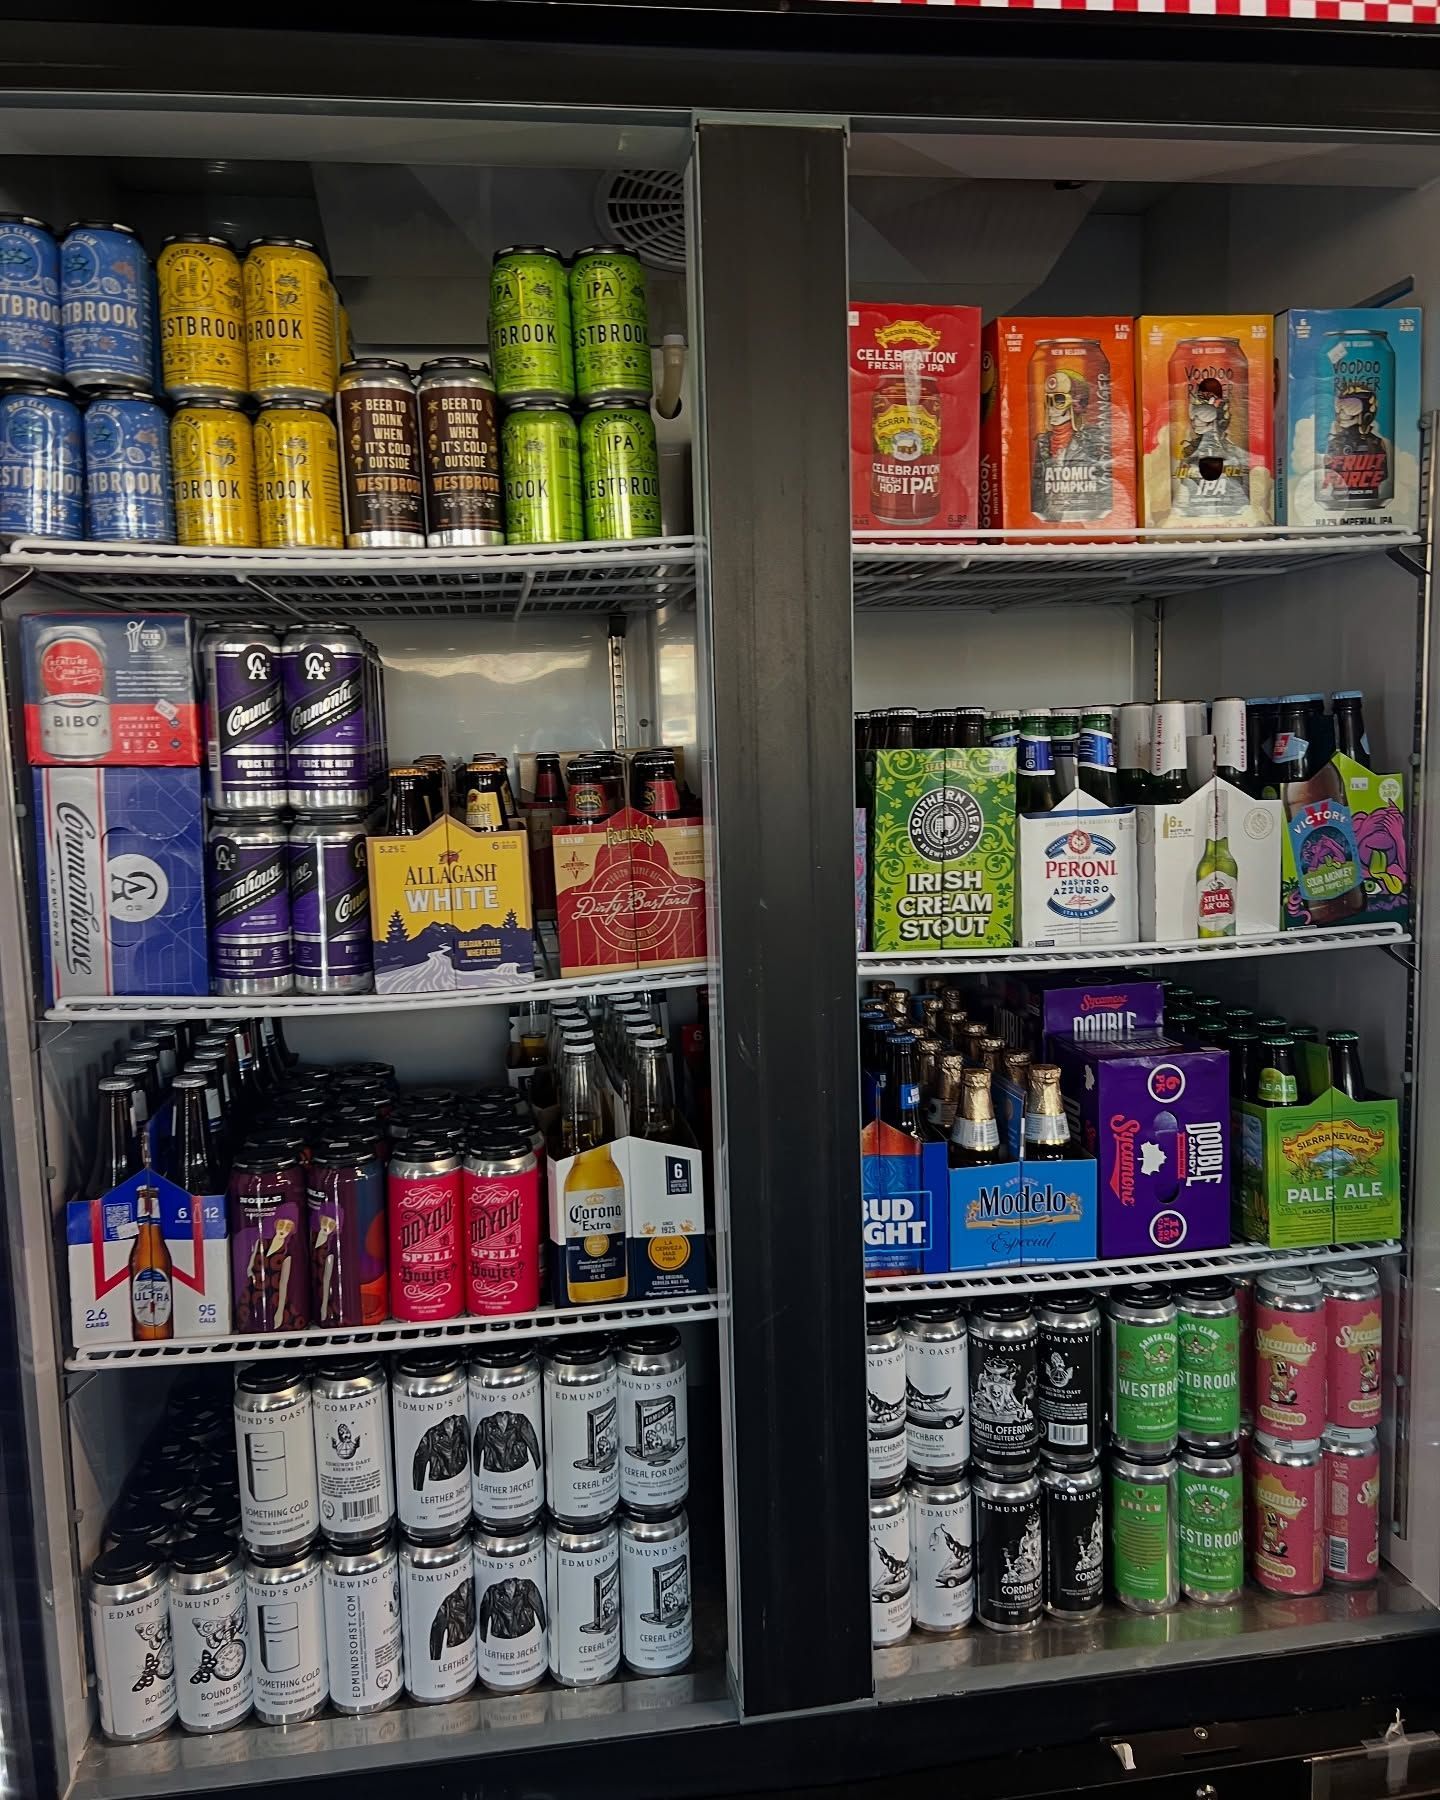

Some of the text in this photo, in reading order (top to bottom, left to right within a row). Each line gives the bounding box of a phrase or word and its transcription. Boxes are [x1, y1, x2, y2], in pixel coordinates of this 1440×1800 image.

[576, 264, 591, 287] INDIA
[613, 266, 627, 281] ALE
[587, 281, 614, 300] IPA
[857, 348, 957, 363] CELEBRATION
[868, 361, 945, 372] FRESH HOP IPA
[1184, 365, 1234, 381] VOODOO
[1333, 359, 1381, 375] VOODOO
[366, 399, 406, 413] BEER TO
[442, 398, 482, 410] BEER TO
[372, 413, 403, 426] DRINK
[447, 413, 479, 425] DRINK
[595, 414, 646, 438] INDIA PALE ALE
[878, 416, 936, 430] SIERRA NEVADA
[374, 428, 403, 440] WHEN
[450, 427, 479, 439] WHEN
[365, 442, 412, 456] IT'S COLD
[441, 441, 488, 454] IT'S COLD
[608, 435, 634, 452] IPA
[369, 456, 410, 470] OUTSIDE
[445, 455, 487, 468] OUTSIDE
[872, 463, 940, 475] CELEBRATION
[1045, 467, 1098, 481] ATOMIC
[878, 476, 901, 484] FRESH
[902, 477, 934, 495] IPA
[880, 483, 902, 494] HOP
[1045, 481, 1097, 494] PUMPKIN
[54, 715, 100, 728] BIBO
[925, 760, 968, 773] SEASONAL
[911, 790, 980, 836] SOUTHERN TIER
[1293, 810, 1347, 835] VICTORY
[606, 824, 655, 848] Founders
[492, 843, 500, 851] 6
[919, 840, 971, 859] BREWING CO
[405, 863, 498, 886] ALLAGASH
[1045, 860, 1118, 879] PERONI
[906, 870, 984, 894] IRISH
[1061, 878, 1100, 887] NASTRO
[1306, 867, 1352, 888] SOUR MONKEY
[57, 801, 101, 976] Commonhouse
[1053, 886, 1110, 896] AZZURRO
[404, 886, 499, 914] WHITE
[572, 883, 698, 925] Dirty Bastard
[1203, 893, 1230, 903] STELLA
[897, 894, 993, 919] CREAM
[1063, 909, 1099, 917] ITALIANA
[899, 916, 989, 942] STOUT
[459, 939, 502, 949] BELGIAN-STYLE
[466, 948, 502, 957] WHEAT BEER
[1155, 1074, 1166, 1094] PK
[1166, 1076, 1181, 1090] 6
[1275, 1083, 1295, 1093] ALE
[1297, 1131, 1370, 1151] SIERRA NEVADA
[1110, 1114, 1141, 1207] Sycamore
[1185, 1121, 1223, 1187] DOUBLE
[1187, 1136, 1195, 1175] CANDY
[673, 1163, 683, 1179] 6
[1287, 1182, 1384, 1204] PALE ALE
[979, 1183, 1067, 1218] Modelo
[178, 1207, 188, 1219] 6
[204, 1207, 219, 1219] 12
[569, 1205, 622, 1225] Corona
[582, 1221, 612, 1232] Extra
[661, 1226, 676, 1234] 1925
[1169, 1219, 1180, 1238] 12
[989, 1231, 1057, 1255] Especial
[402, 1250, 453, 1264] SPELL
[471, 1248, 520, 1260] SPELL
[134, 1292, 170, 1302] ULTRA
[86, 1308, 108, 1322] 2.6
[199, 1304, 216, 1317] 95
[85, 1321, 110, 1329] CARBS
[1199, 1325, 1221, 1340] CLAW
[1000, 1343, 1027, 1352] OAST
[1139, 1334, 1163, 1349] SANTA
[1256, 1328, 1318, 1355] Sycamore
[930, 1347, 955, 1356] OAST
[512, 1386, 537, 1400] OAST
[555, 1387, 610, 1401] EDMUND'S
[324, 1397, 379, 1413] COMPANY
[280, 1406, 306, 1423] OAST
[1262, 1407, 1305, 1424] CHURRO
[655, 1421, 675, 1437] OATS
[996, 1422, 1034, 1436] OFFERING
[993, 1433, 1015, 1442] BUTTER
[624, 1466, 667, 1479] CEREAL FOR
[478, 1479, 535, 1494] LEATHER JACKET
[572, 1480, 601, 1490] CEREAL
[1185, 1484, 1231, 1498] SANTA CLAW
[420, 1492, 454, 1504] LEATHER
[246, 1500, 310, 1519] SOMETHING COLD
[981, 1501, 1034, 1513] EDMUND'S
[624, 1544, 677, 1556] EDMUND'S
[562, 1551, 615, 1567] EDMUND'S
[412, 1563, 467, 1582] EDMUND'S
[294, 1574, 320, 1594] OAST
[328, 1576, 379, 1589] BREWING
[1001, 1584, 1034, 1596] CORDIAL
[1014, 1592, 1033, 1601] PEANUT
[109, 1590, 168, 1620] EDMUND'S
[172, 1592, 231, 1609] EDMUND'S
[640, 1631, 682, 1643] CEREAL FOR
[347, 1595, 361, 1698] EDMUNDSOAST.COM
[484, 1642, 541, 1660] LEATHER JACKET
[578, 1642, 605, 1654] CEREAL
[439, 1656, 469, 1673] LEATHER
[257, 1668, 321, 1689] SOMETHING COLD
[144, 1685, 173, 1706] BOUND
[201, 1684, 242, 1701] BOUND BY
